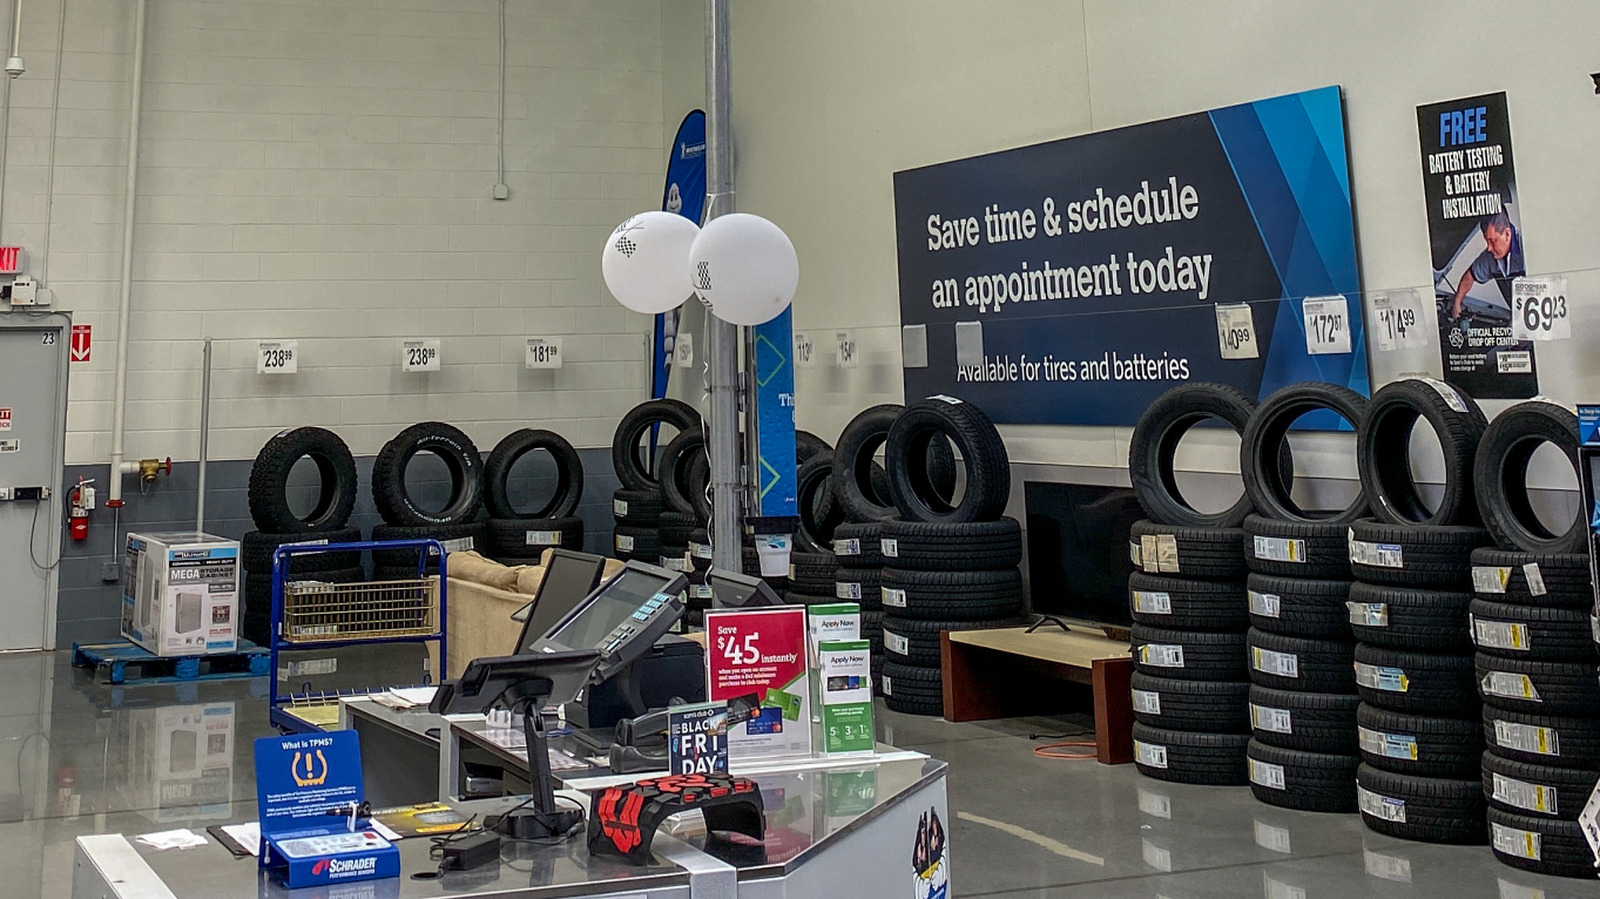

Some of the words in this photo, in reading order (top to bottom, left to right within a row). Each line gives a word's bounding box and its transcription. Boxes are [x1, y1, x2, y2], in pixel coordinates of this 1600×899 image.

[1439, 106, 1488, 147] FREE
[1428, 150, 1465, 174] BATTERY
[1466, 145, 1504, 168] TESTING
[1445, 175, 1454, 196] &
[1454, 170, 1491, 194] BATTERY
[927, 213, 980, 252] Save
[984, 204, 1036, 244] time
[1042, 196, 1062, 238] &
[1067, 176, 1200, 234] schedule
[1442, 193, 1502, 219] INSTALLATION
[0, 247, 21, 271] XIT
[932, 277, 960, 309] an
[964, 254, 1122, 314] appointment
[1126, 246, 1213, 300] today
[1515, 282, 1547, 290] GOODYEAR
[42, 332, 56, 345] 23
[1467, 328, 1491, 338] OFFICIAL
[1468, 338, 1484, 347] DROP
[1484, 338, 1495, 346] OFF
[957, 355, 1019, 382] Available
[1019, 353, 1041, 380] for
[1042, 354, 1077, 380] tires
[1079, 353, 1110, 381] and
[1112, 351, 1191, 381] batteries
[171, 568, 200, 580] MEGA
[718, 625, 738, 634] Save
[822, 620, 842, 630] Apply
[842, 618, 856, 627] Now
[718, 632, 761, 666] $45
[831, 655, 849, 665] Apply
[850, 653, 867, 663] Now
[682, 720, 718, 734] BLACK
[282, 741, 301, 750] What
[309, 737, 333, 748] TPMS?
[682, 733, 719, 756] FRI
[682, 755, 718, 775] DAY
[329, 857, 378, 873] SCHRADER
